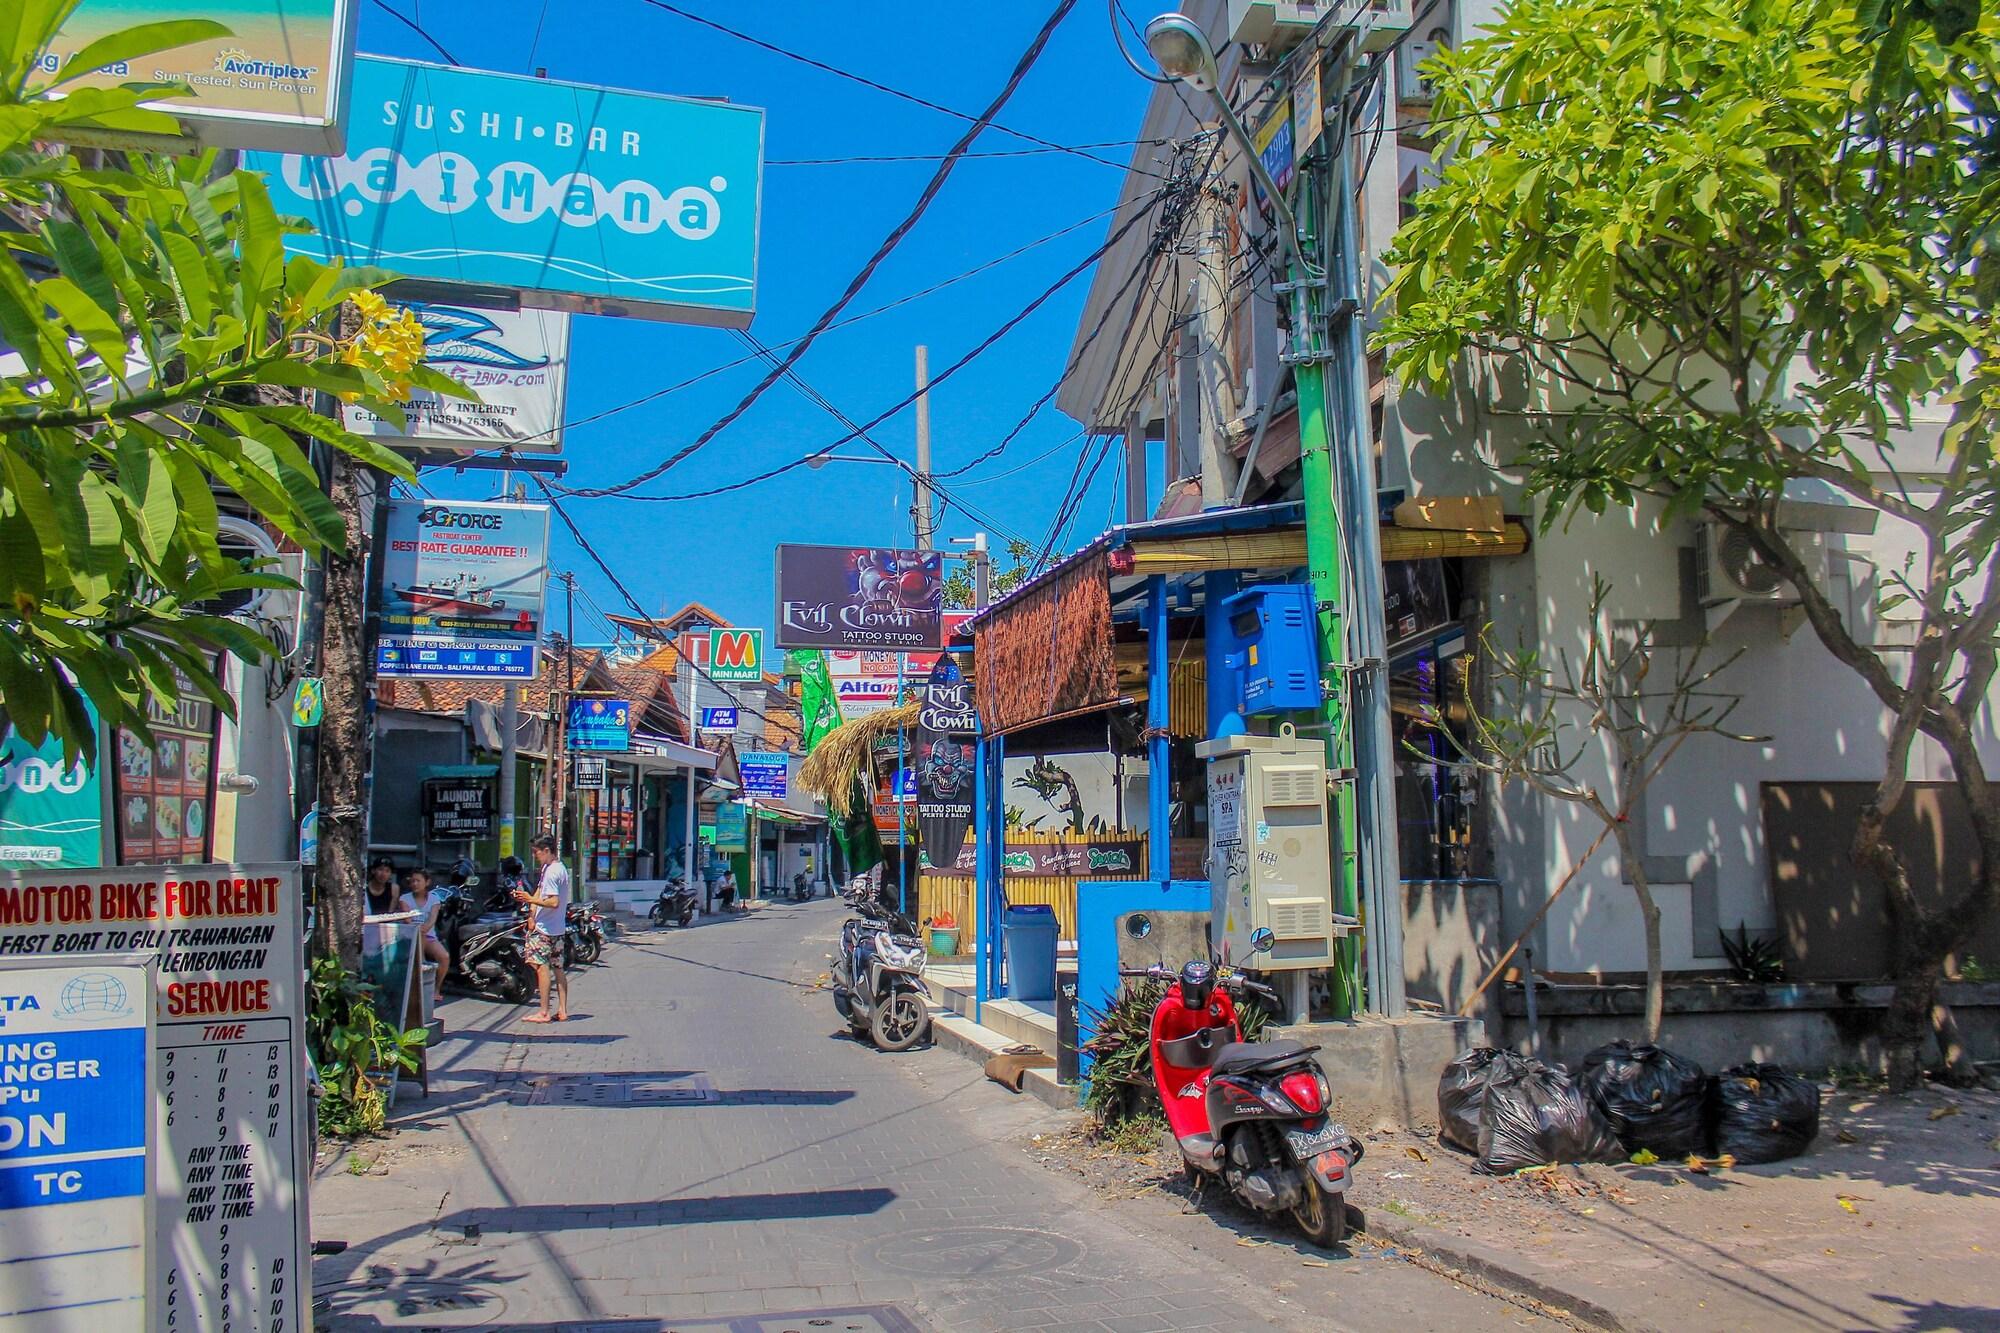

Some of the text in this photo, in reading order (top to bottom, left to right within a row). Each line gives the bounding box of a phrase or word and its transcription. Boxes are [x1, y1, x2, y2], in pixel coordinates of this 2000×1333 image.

[154, 70, 181, 81] Sun
[239, 78, 265, 90] Sun
[269, 80, 317, 95] Proven
[456, 402, 518, 416] INTERNET
[392, 540, 418, 552] BEST
[420, 541, 448, 554] RATE
[450, 544, 517, 558] GUARANTEE
[783, 600, 912, 634] Evil Clown
[841, 630, 924, 643] TATTOO STUDIO
[421, 651, 437, 659] VISA
[864, 650, 890, 663] MONEY
[712, 670, 759, 680] MINI MART
[864, 664, 876, 672] NO
[928, 684, 969, 712] Evil
[615, 708, 627, 726] 3
[714, 710, 730, 718] ATM
[919, 708, 976, 732] Clown
[436, 789, 484, 803] LAUNDRY
[918, 804, 944, 814] TATTOO
[945, 804, 972, 814] STUDIO
[1221, 801, 1234, 815] SPA
[450, 818, 472, 829] MOTOR
[472, 818, 488, 828] BIKE
[3, 848, 58, 860] Free Wi-Fi
[1040, 849, 1082, 867] Sandwiches
[0, 876, 281, 924] MOTOR BIKE FOR RENT
[1, 924, 275, 954] FAST BOAT TO GILI TRAWANGAN
[162, 949, 267, 973] LEMBONGAN
[167, 978, 271, 1017] SERVICE
[202, 1024, 246, 1042] TIME
[165, 1051, 175, 1067] 9
[267, 1045, 279, 1061] 13
[165, 1070, 175, 1087] 9
[267, 1064, 278, 1080] 13
[166, 1083, 280, 1106] 6 8 10
[166, 1103, 280, 1128] 6 8 10
[218, 1126, 227, 1142] 9
[1328, 1123, 1346, 1137] KG
[187, 1143, 252, 1165] ANY TIME
[186, 1163, 254, 1184] ANY TIME
[34, 1170, 83, 1197] TC
[186, 1182, 255, 1204] ANY TIME
[186, 1200, 255, 1223] ANY TIME
[219, 1223, 229, 1240] 9
[220, 1243, 229, 1260] 9
[168, 1257, 284, 1285] 6 8 10
[168, 1278, 283, 1306] 6 8 10
[168, 1298, 283, 1326] 6 8 10
